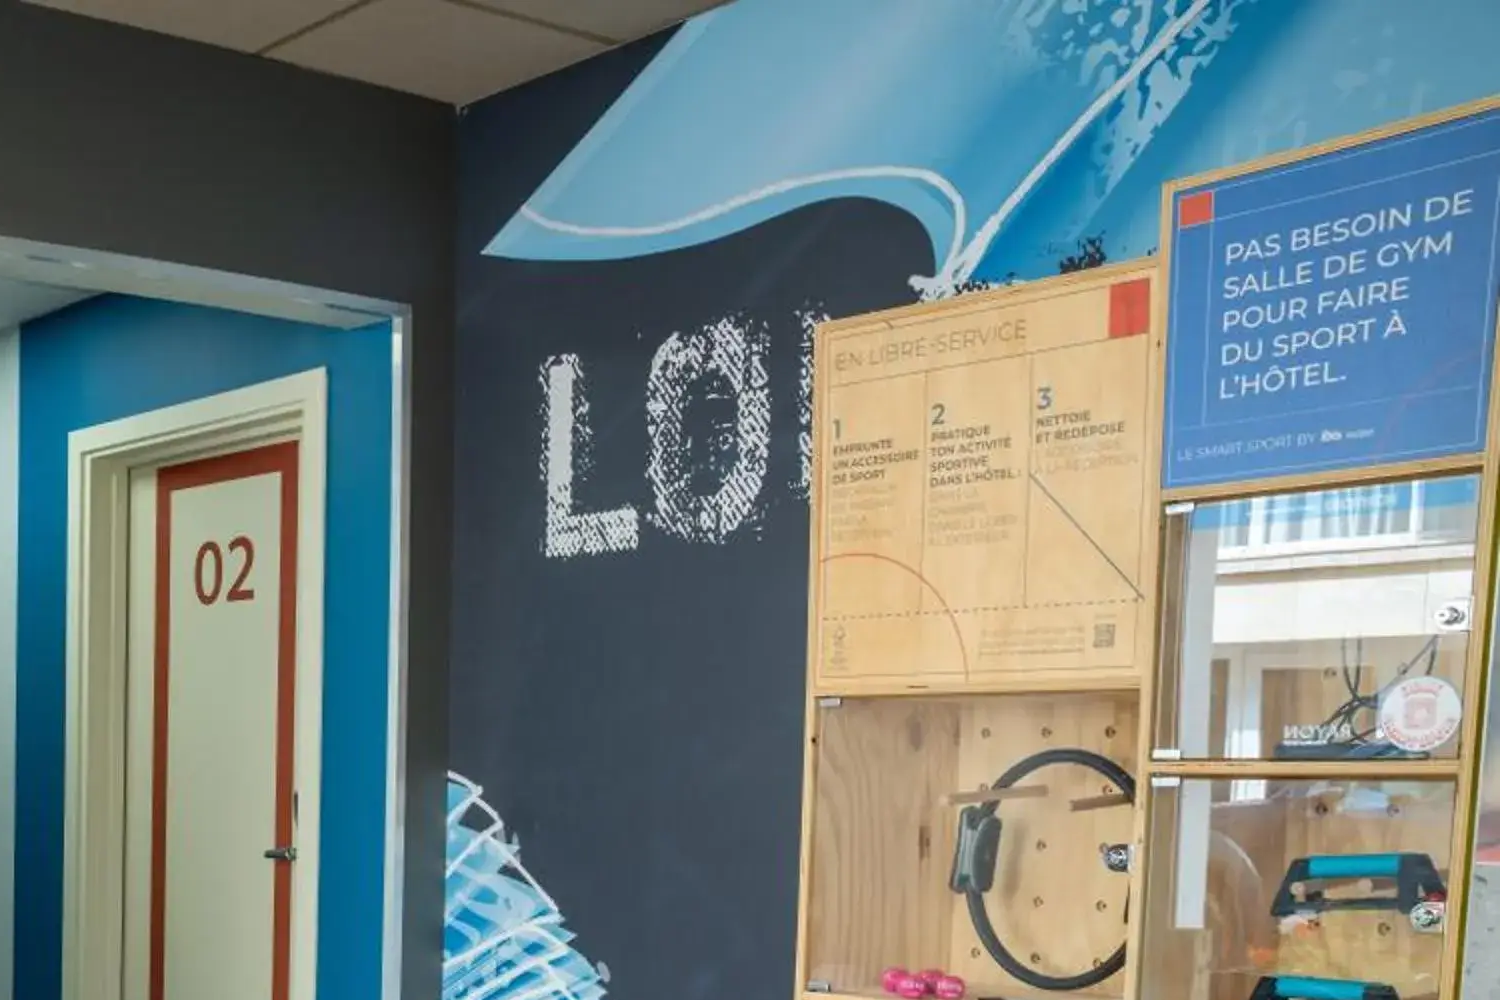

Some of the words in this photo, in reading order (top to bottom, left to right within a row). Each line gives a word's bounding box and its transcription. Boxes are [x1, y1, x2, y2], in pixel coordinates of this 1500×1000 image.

[1225, 234, 1281, 266] PAS
[1290, 203, 1412, 252] BESOIN
[1424, 189, 1475, 223] DE
[1223, 261, 1313, 300] SALLE
[1323, 249, 1367, 281] DE
[1377, 231, 1453, 268] GYM
[1222, 297, 1307, 334] POUR
[1317, 276, 1410, 315] FAIRE
[1221, 339, 1263, 367] DU
[1273, 318, 1376, 359] SPORT
[1383, 309, 1407, 337] À
[835, 350, 863, 372] EN
[1219, 361, 1347, 400] L'HÔTEL.
[1036, 386, 1052, 410] 3
[931, 403, 945, 425] 2
[1035, 409, 1091, 428] NETTOIE
[538, 316, 815, 557] LO
[833, 418, 841, 439] 1
[930, 424, 991, 443] PRATIQUE
[1035, 431, 1050, 445] ET
[833, 438, 893, 457] EMPRUNTE
[931, 444, 955, 458] TON
[832, 458, 848, 471] UN
[849, 449, 920, 469] ACCESSOIRE
[930, 455, 989, 473] SPORTIVE
[831, 473, 848, 486] DE
[849, 468, 886, 484] SPORT
[930, 475, 963, 489] DANS
[194, 535, 255, 606] 02
